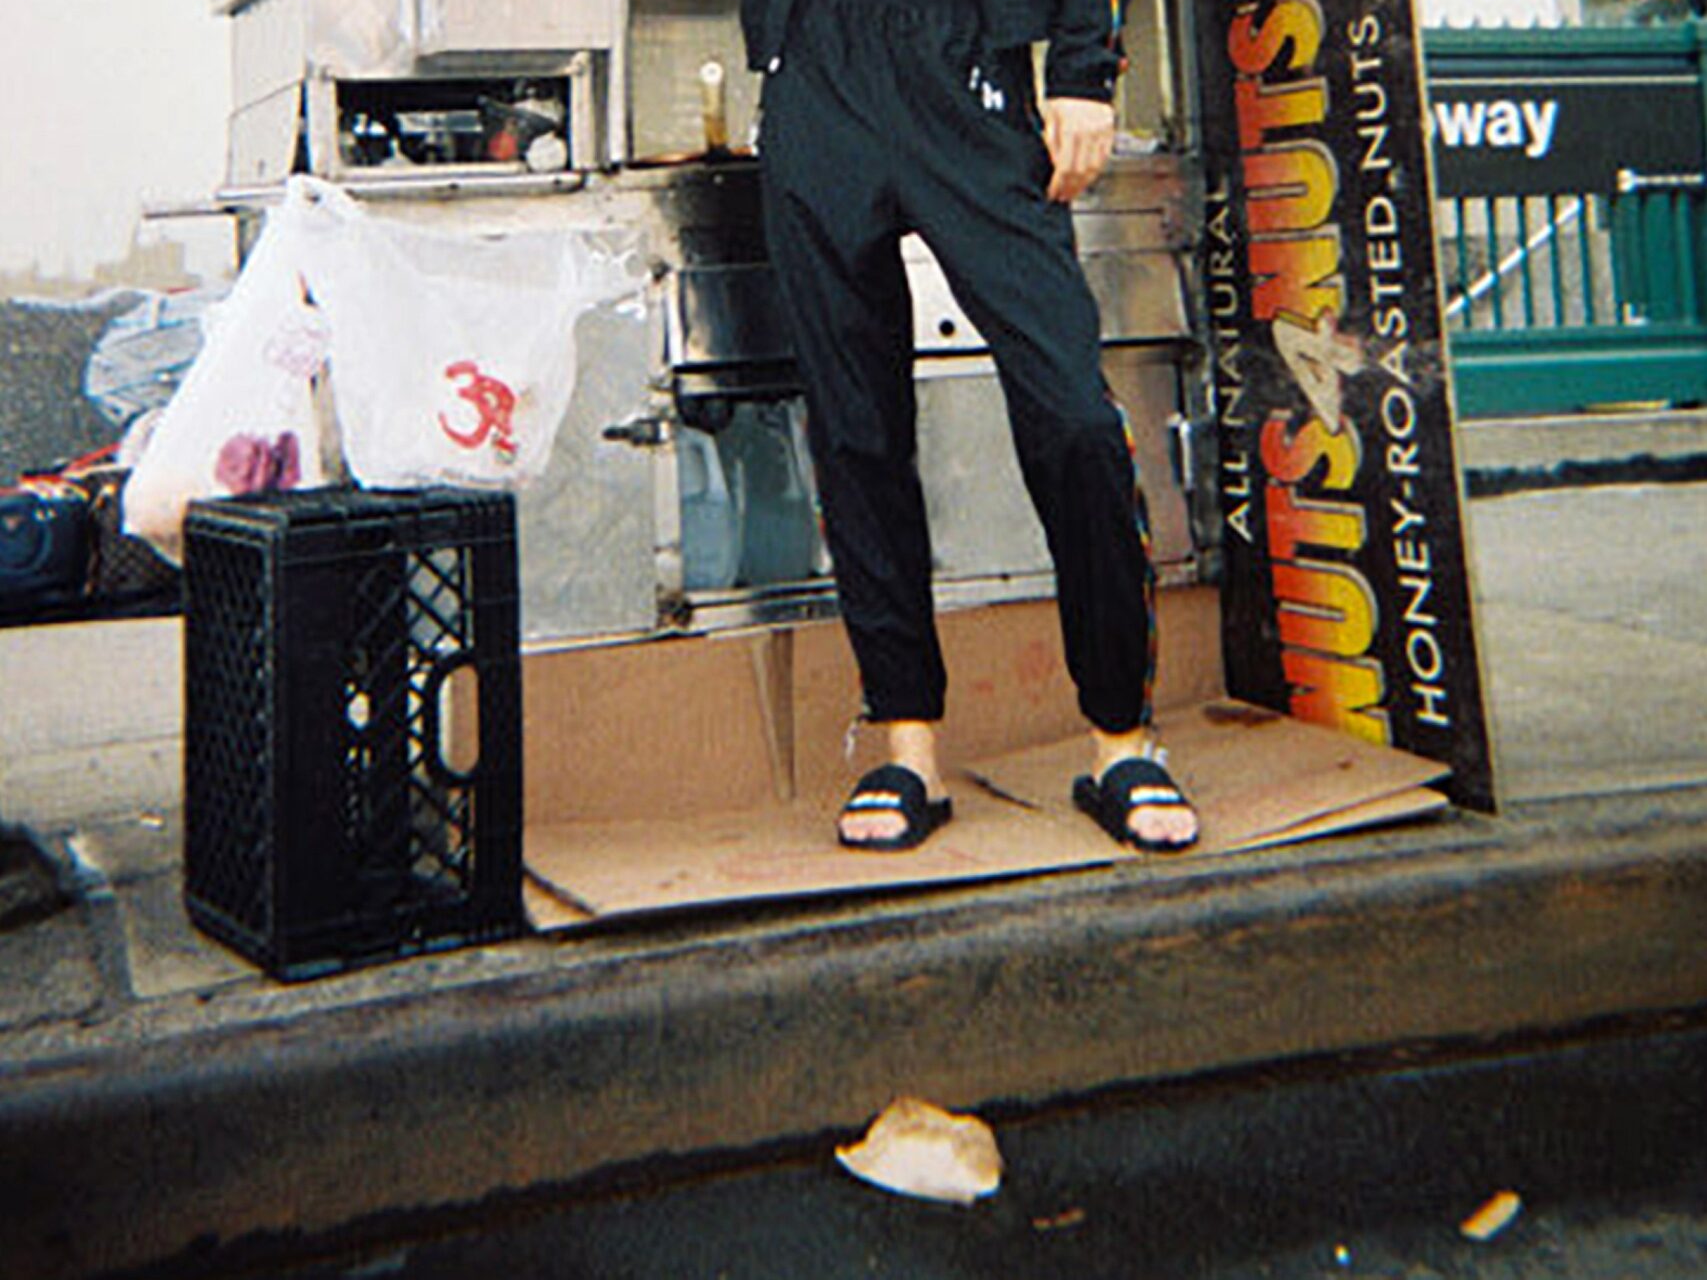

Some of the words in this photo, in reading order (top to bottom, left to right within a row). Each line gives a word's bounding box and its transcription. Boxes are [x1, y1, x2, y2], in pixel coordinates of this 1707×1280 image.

[1349, 13, 1391, 170] NUTS
[1427, 99, 1558, 158] way
[1205, 180, 1246, 426] NATURAL
[1226, 448, 1254, 544] ALL
[1369, 197, 1449, 725] HONEY-ROASTED
